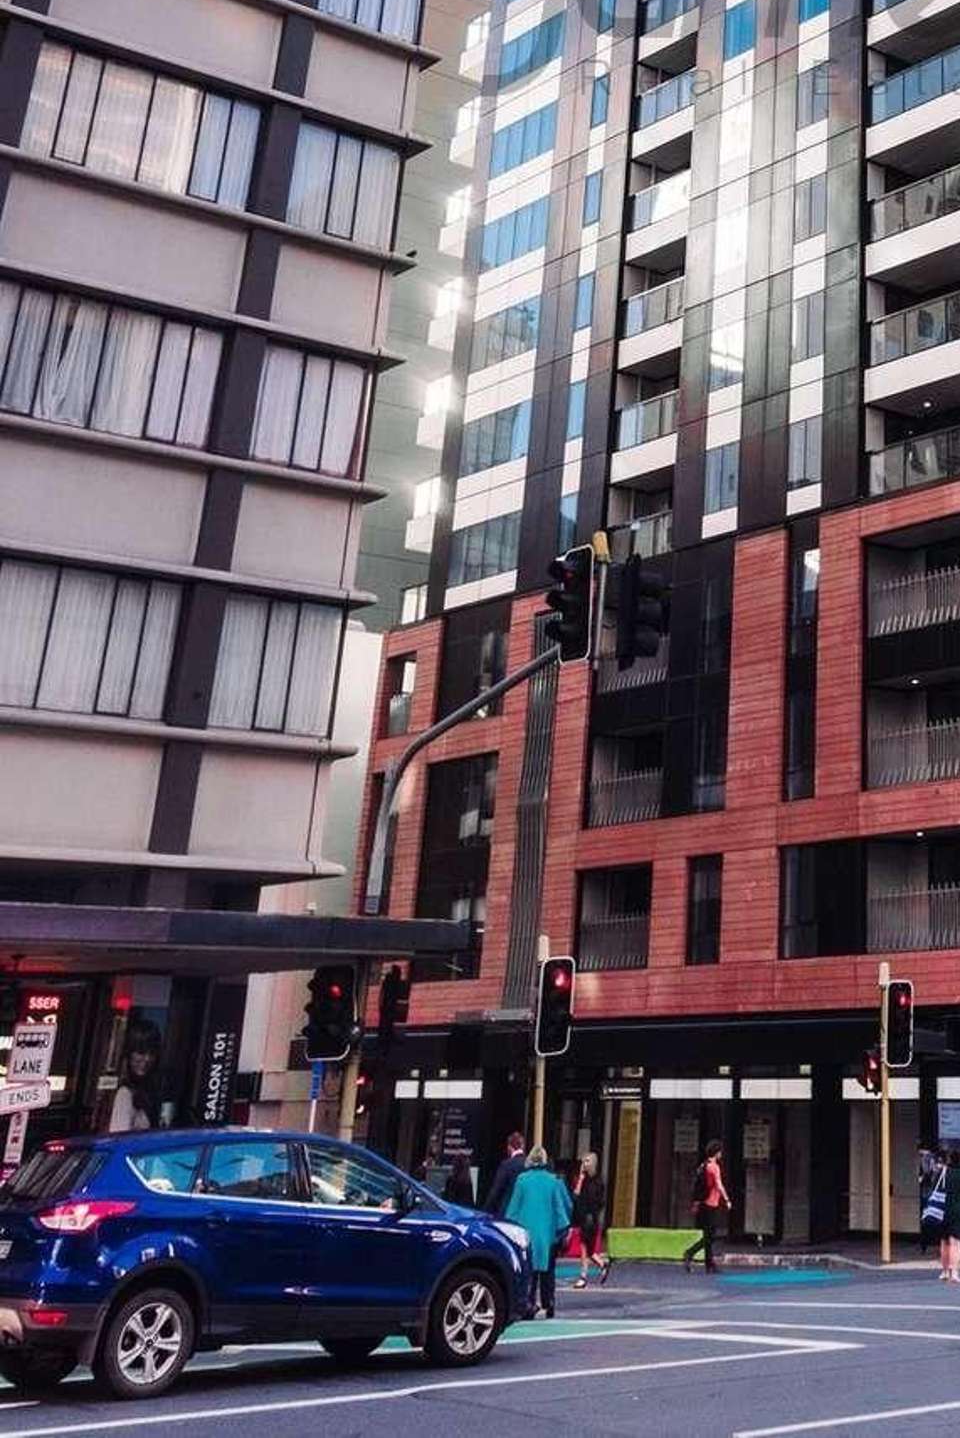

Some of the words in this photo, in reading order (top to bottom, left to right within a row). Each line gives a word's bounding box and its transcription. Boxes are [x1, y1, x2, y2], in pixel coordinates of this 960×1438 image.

[13, 1061, 43, 1075] LANE
[204, 1064, 222, 1120] SALON
[213, 1033, 227, 1058] 101
[8, 1088, 41, 1106] ENDS
